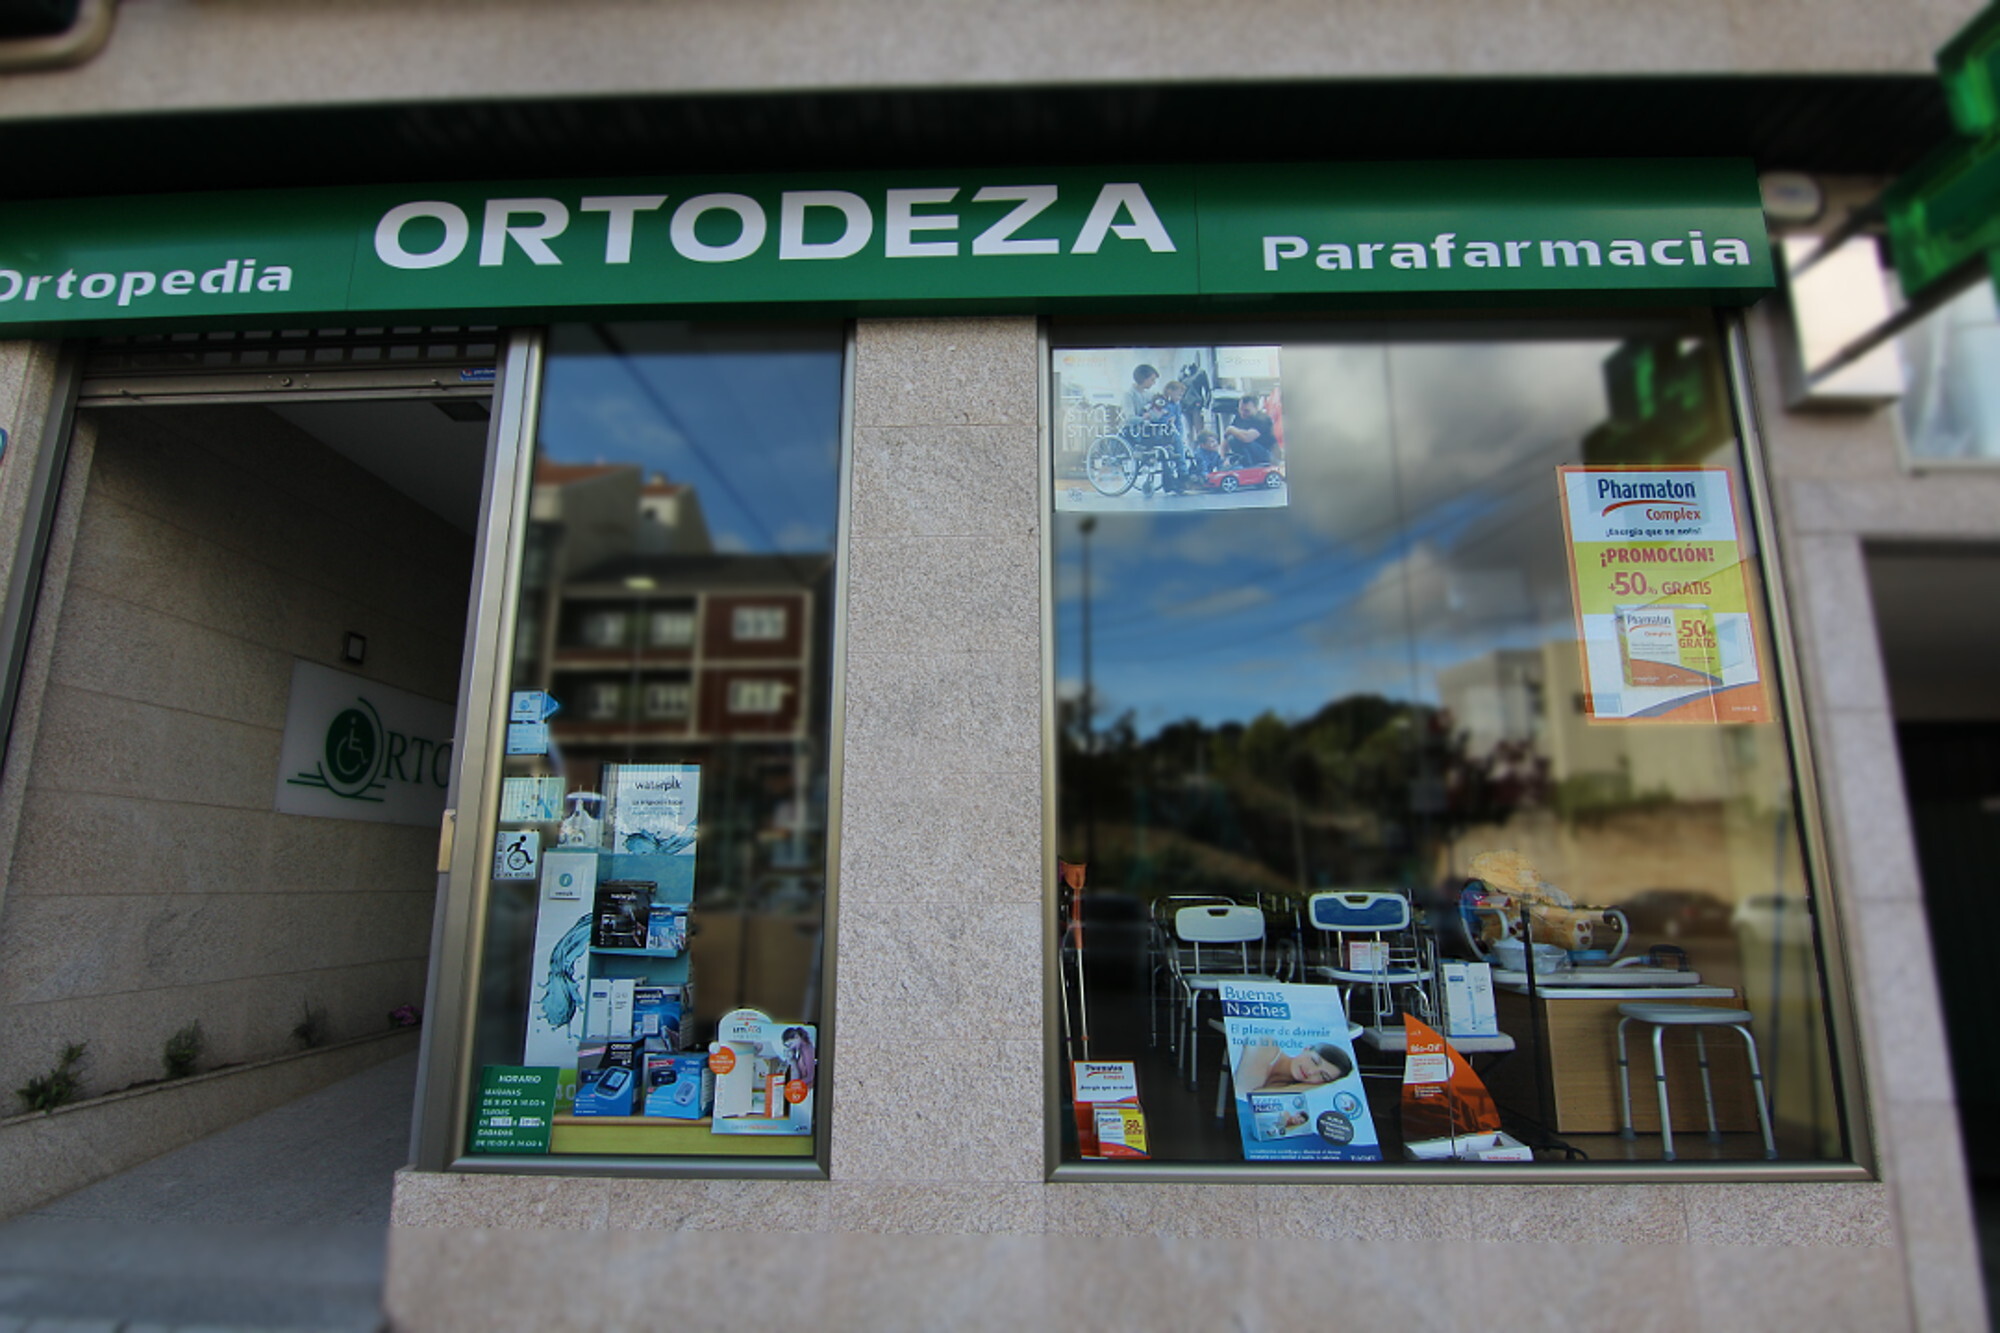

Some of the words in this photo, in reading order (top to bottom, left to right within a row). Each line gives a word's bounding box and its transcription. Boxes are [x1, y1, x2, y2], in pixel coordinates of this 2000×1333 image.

[374, 183, 1177, 269] ORTODEZA
[1262, 231, 1750, 271] Parafarmacia
[0, 259, 292, 306] Ortopedia
[1067, 424, 1112, 437] STYLE
[1130, 423, 1180, 437] ULTRA
[1597, 478, 1696, 498] Pharmaton
[1645, 507, 1701, 524] Complex
[1645, 529, 1663, 537] que
[1600, 543, 1715, 568] ¡PROMOCIÓN!
[1661, 581, 1712, 595] GRATIS
[635, 775, 681, 791] waterpik
[1225, 986, 1284, 1001] Buenas
[1226, 1002, 1287, 1017] Noches
[1231, 1024, 1239, 1034] El
[1242, 1024, 1276, 1036] placer
[1278, 1026, 1289, 1035] de
[1292, 1026, 1331, 1037] dormir
[1271, 1038, 1304, 1049] noche
[498, 1074, 542, 1083] HORARIO
